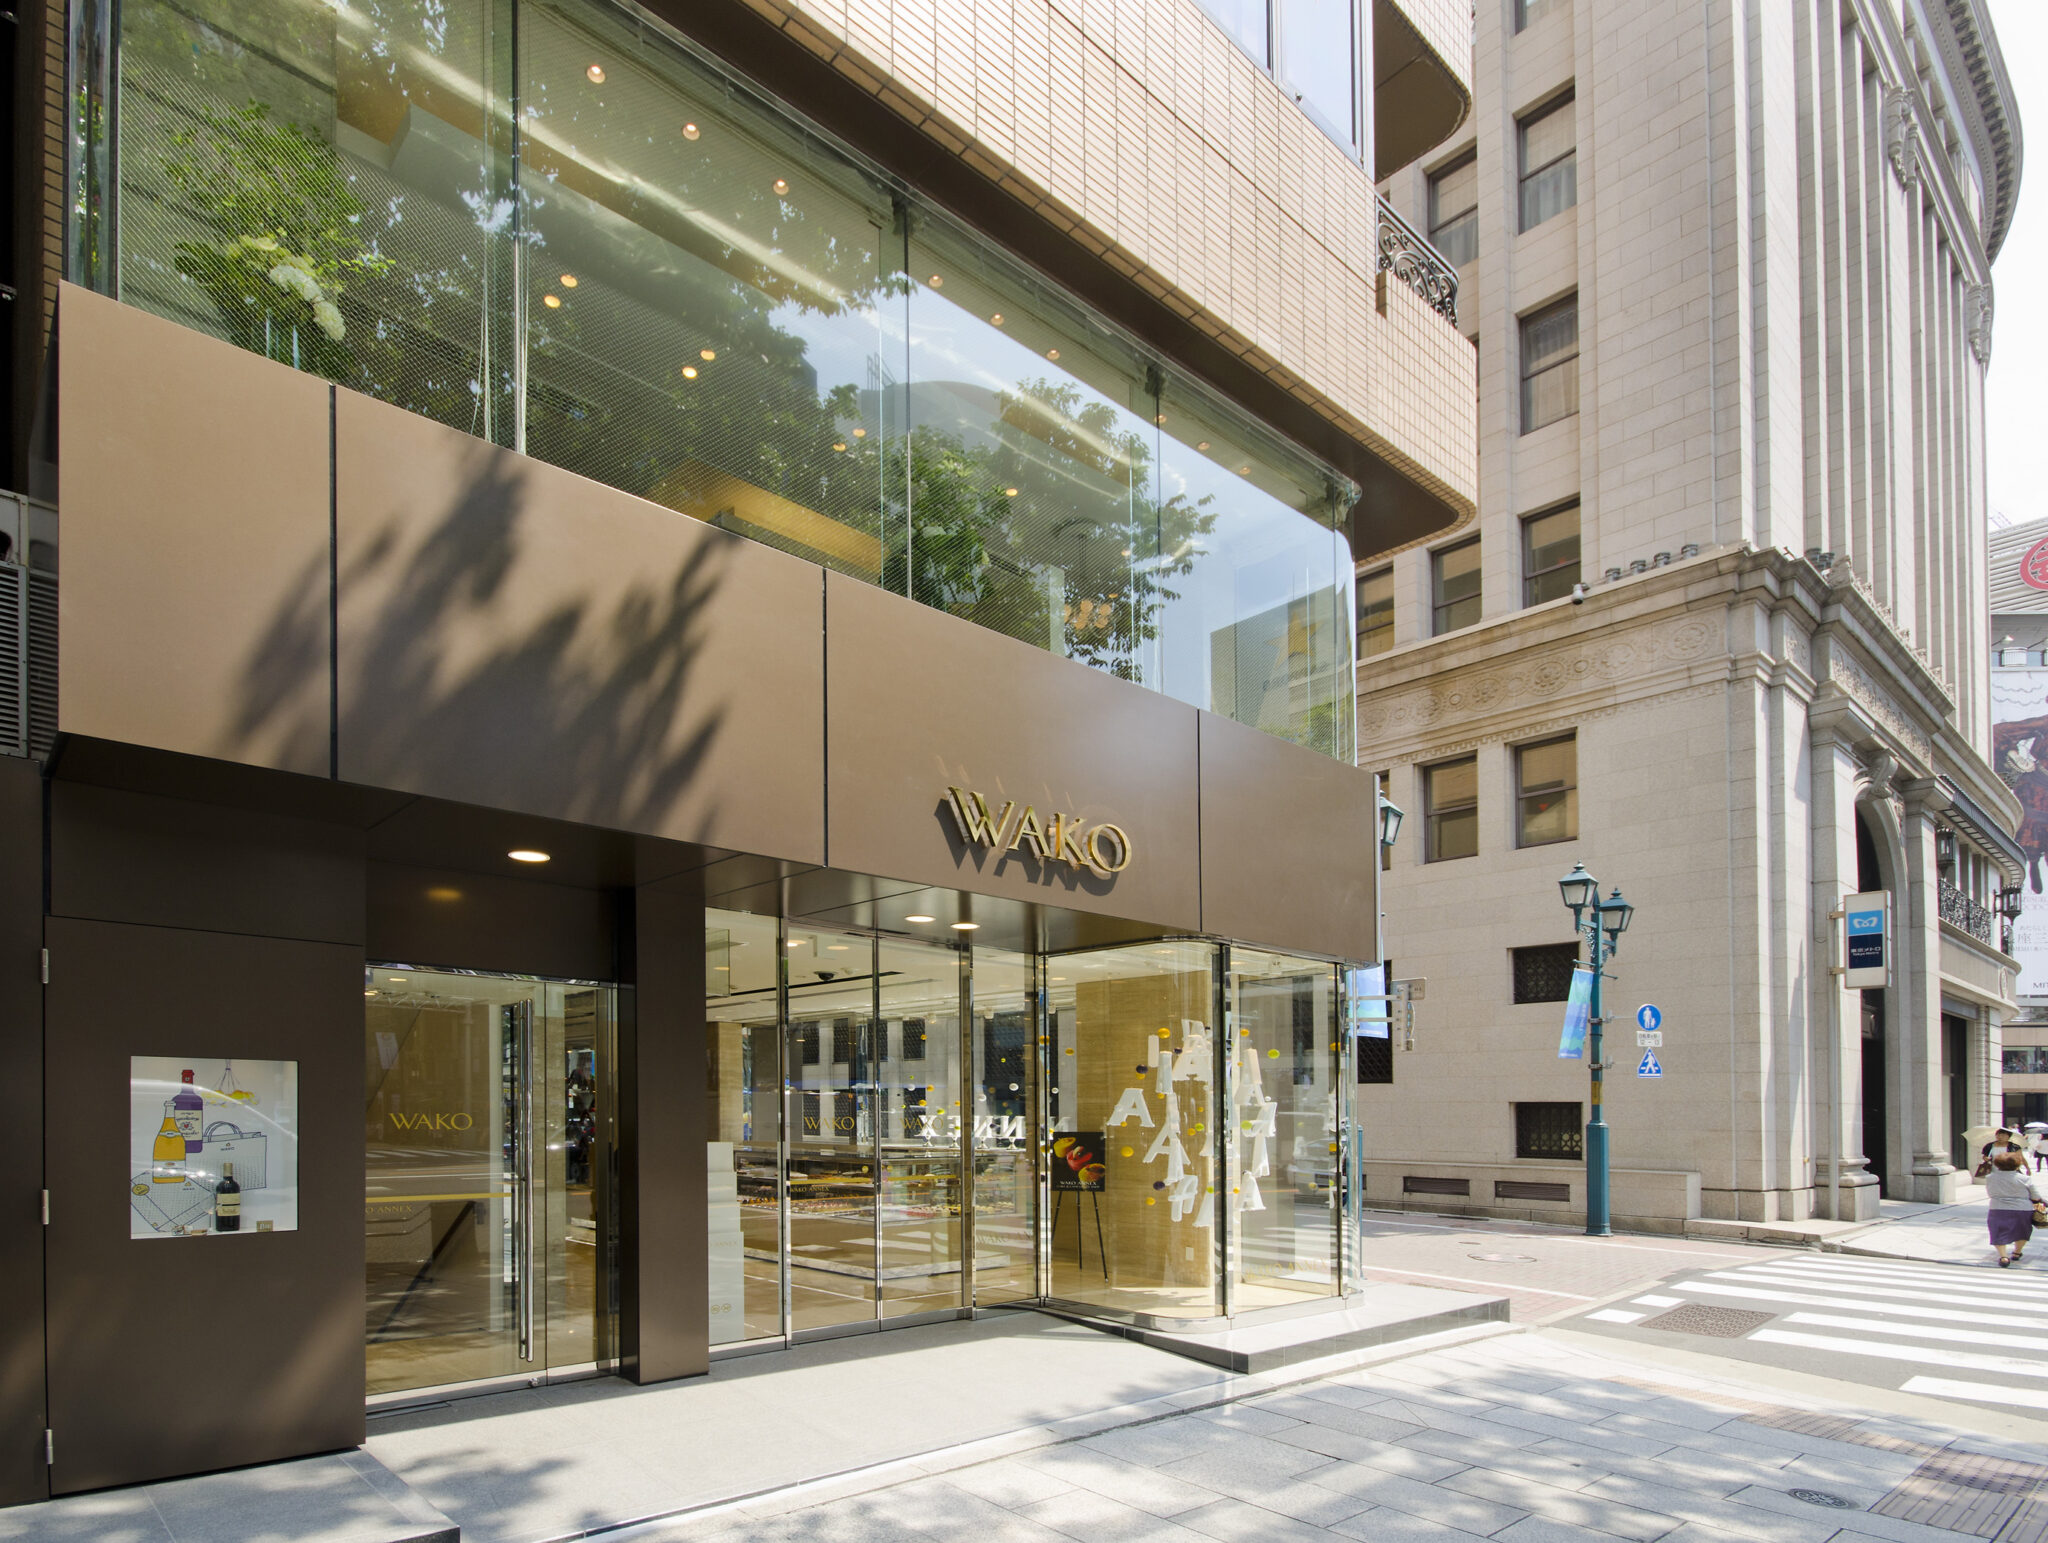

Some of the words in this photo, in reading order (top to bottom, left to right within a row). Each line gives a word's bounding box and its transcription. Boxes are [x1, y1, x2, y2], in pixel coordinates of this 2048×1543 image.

[947, 785, 1132, 873] WAKO
[389, 1112, 473, 1131] WAKO
[804, 1116, 855, 1130] WAKO
[378, 1204, 413, 1214] ANNEX
